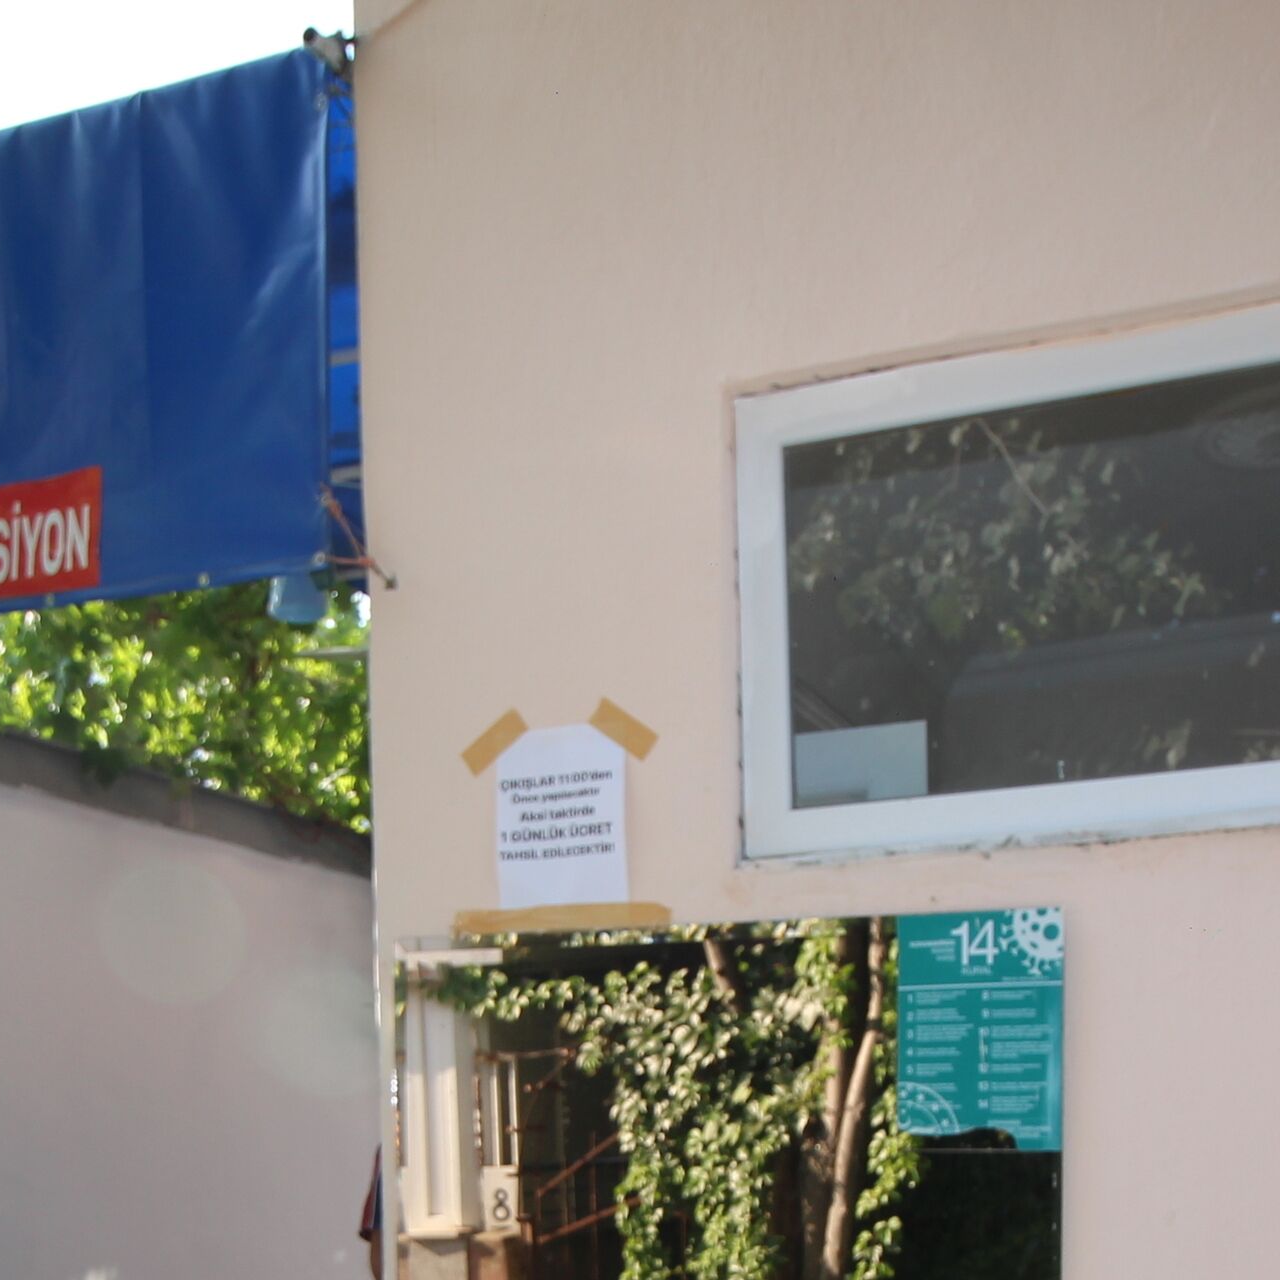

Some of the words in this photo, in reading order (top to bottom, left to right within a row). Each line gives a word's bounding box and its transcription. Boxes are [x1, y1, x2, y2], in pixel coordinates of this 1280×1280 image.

[500, 777, 556, 792] ÇIKIŞLAR
[511, 825, 567, 842] GÜNLÜK
[569, 821, 613, 837] ÜCRET
[500, 848, 539, 861] TAHSİL
[950, 918, 1000, 966] 14
